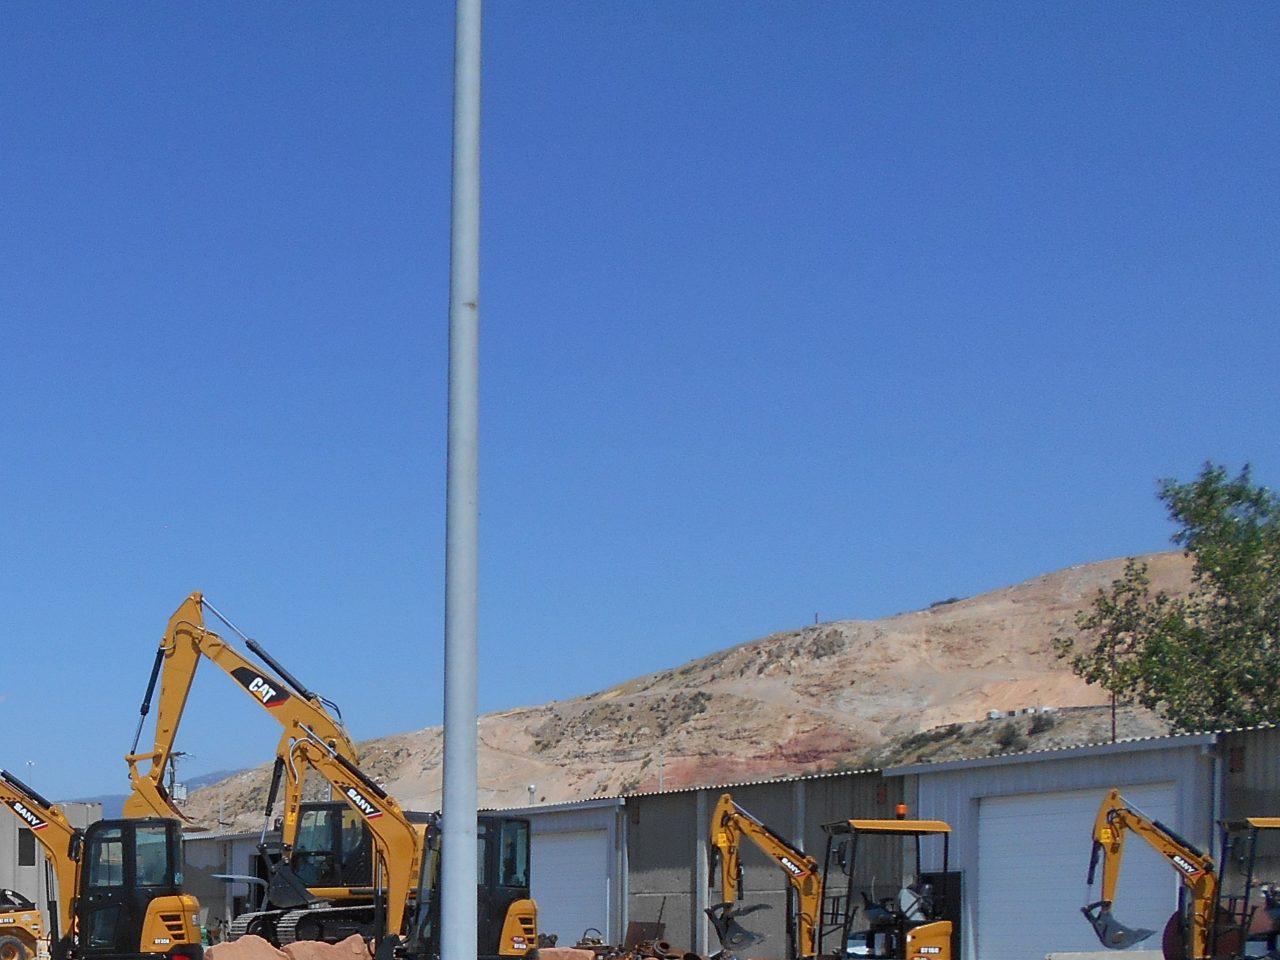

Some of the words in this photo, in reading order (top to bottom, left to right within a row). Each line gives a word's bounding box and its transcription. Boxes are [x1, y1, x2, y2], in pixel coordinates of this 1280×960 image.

[248, 676, 277, 704] CAT
[347, 788, 374, 813] SANY
[13, 802, 40, 825] SANY
[1173, 855, 1196, 873] SANY
